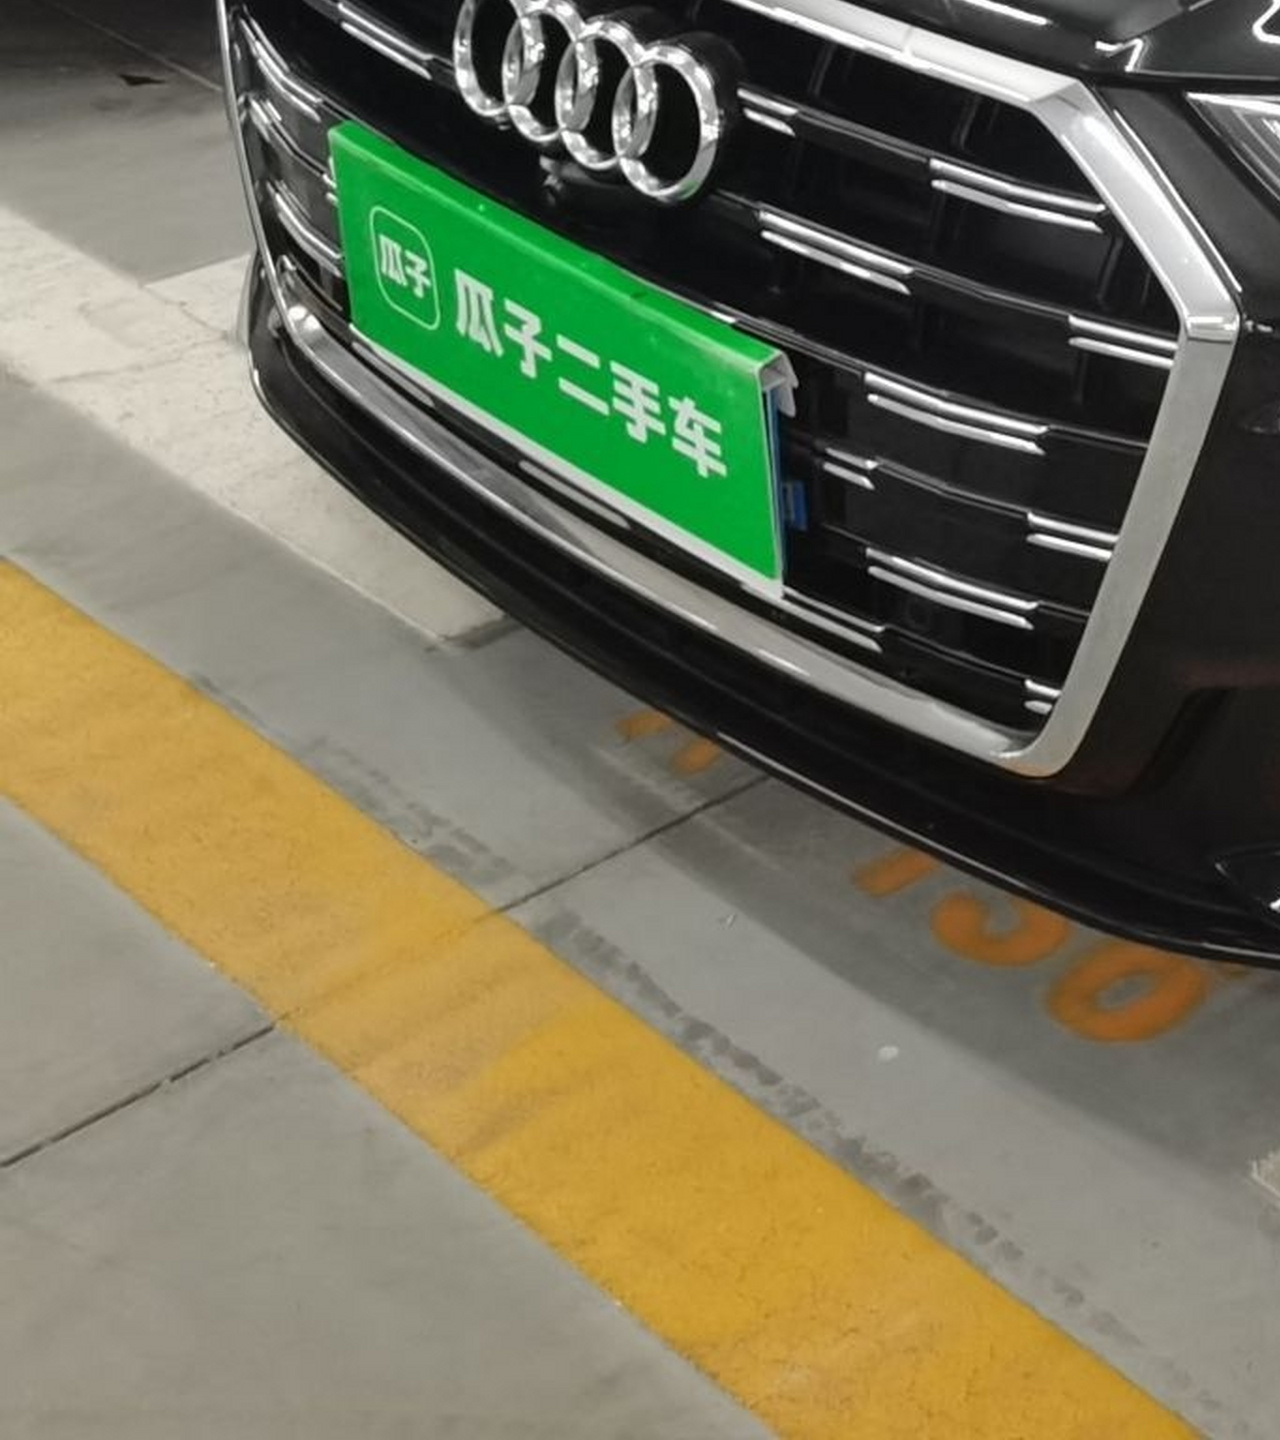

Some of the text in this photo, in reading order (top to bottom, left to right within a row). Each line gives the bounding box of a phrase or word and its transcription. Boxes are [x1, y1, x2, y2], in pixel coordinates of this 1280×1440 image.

[379, 234, 432, 299] 瓜子
[454, 268, 727, 478] 瓜子二手车
